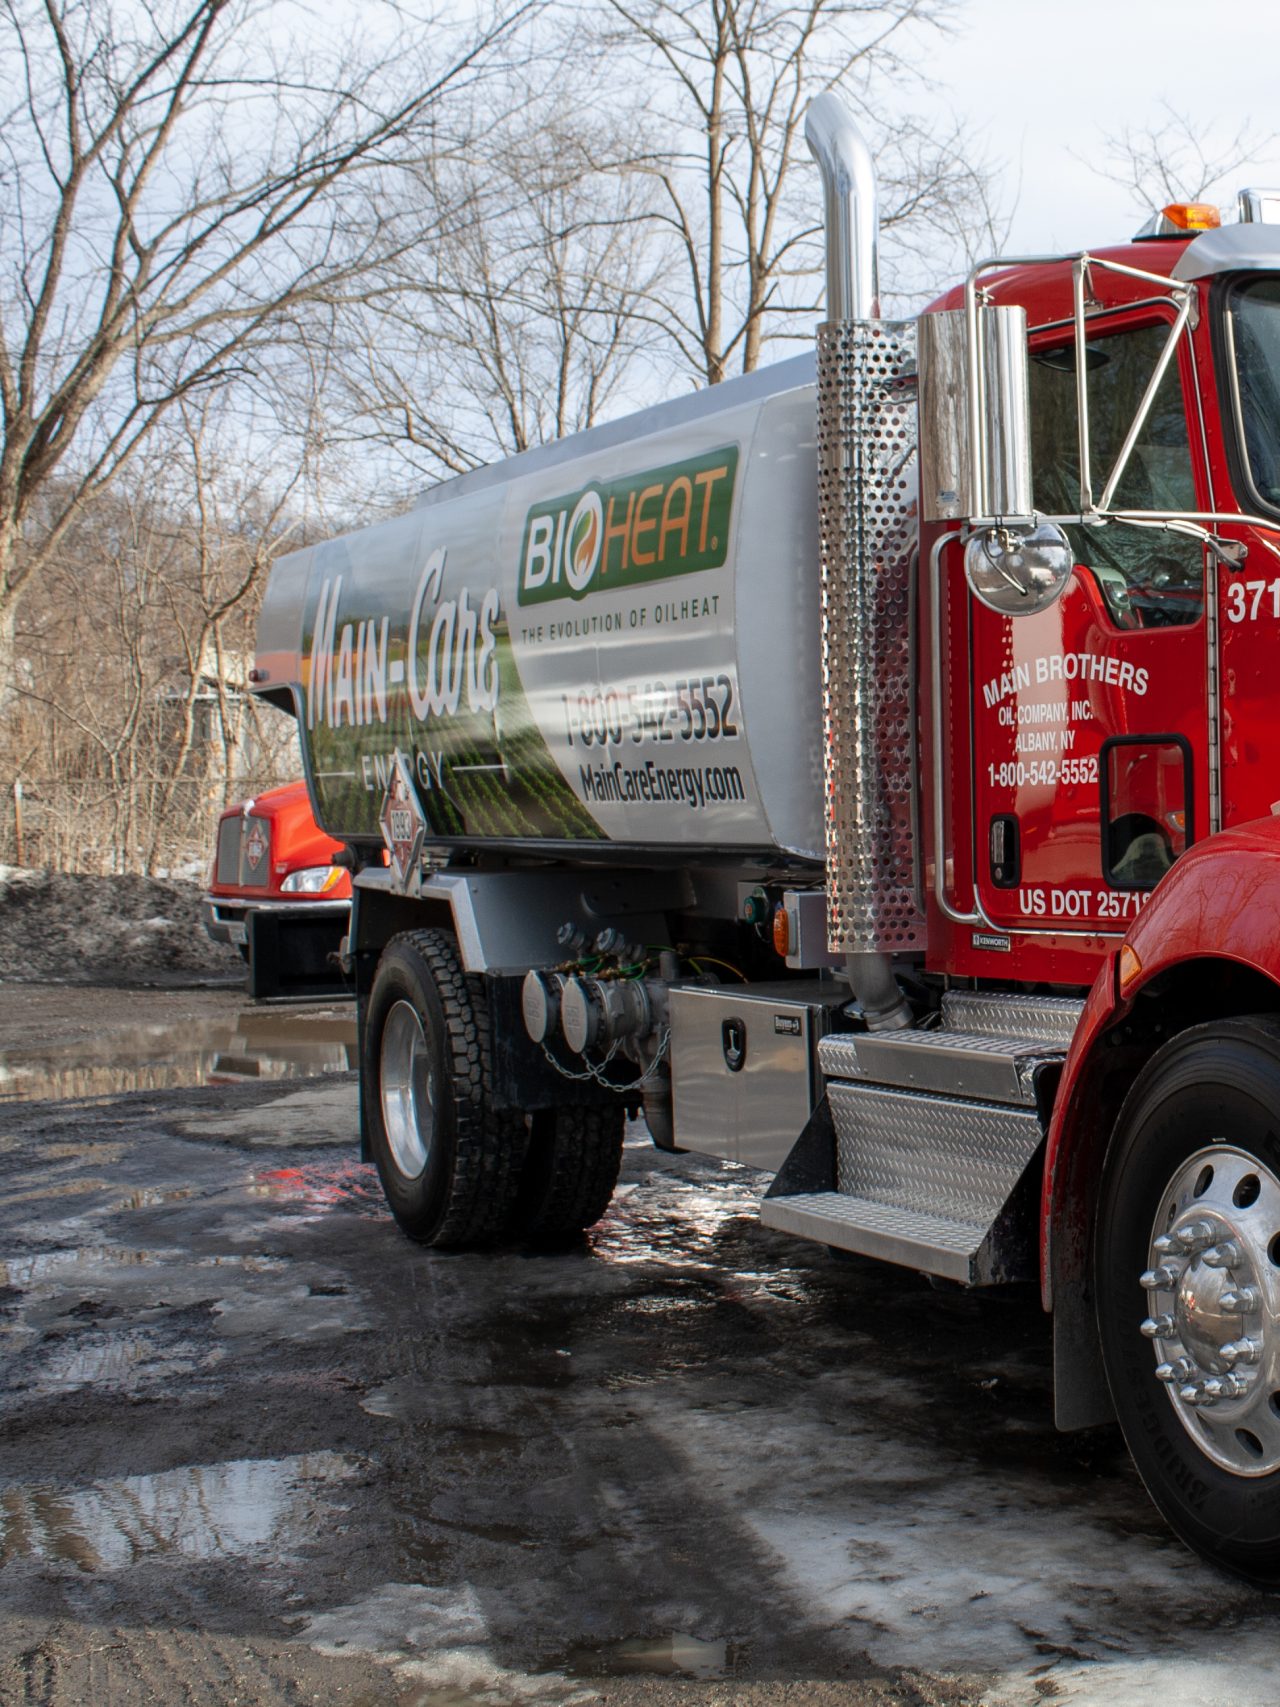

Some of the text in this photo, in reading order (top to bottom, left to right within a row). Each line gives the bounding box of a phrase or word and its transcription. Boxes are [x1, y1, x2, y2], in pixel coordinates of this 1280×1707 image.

[1227, 578, 1280, 623] 371
[522, 595, 720, 645] THE EVOLUTION OF OILHEAT
[983, 652, 1149, 708] MAIN BROTHERS
[562, 674, 739, 746] 1-800-542-5552
[999, 700, 1094, 726] OIL COMPANY, INC.
[1015, 730, 1076, 753] ALBANY, NY
[580, 761, 745, 808] MainCareEnergy.com
[988, 757, 1098, 787] 1-800-542-5552
[1020, 889, 1046, 915] US
[1051, 890, 1092, 916] DOT
[980, 936, 1008, 946] KENWORTH
